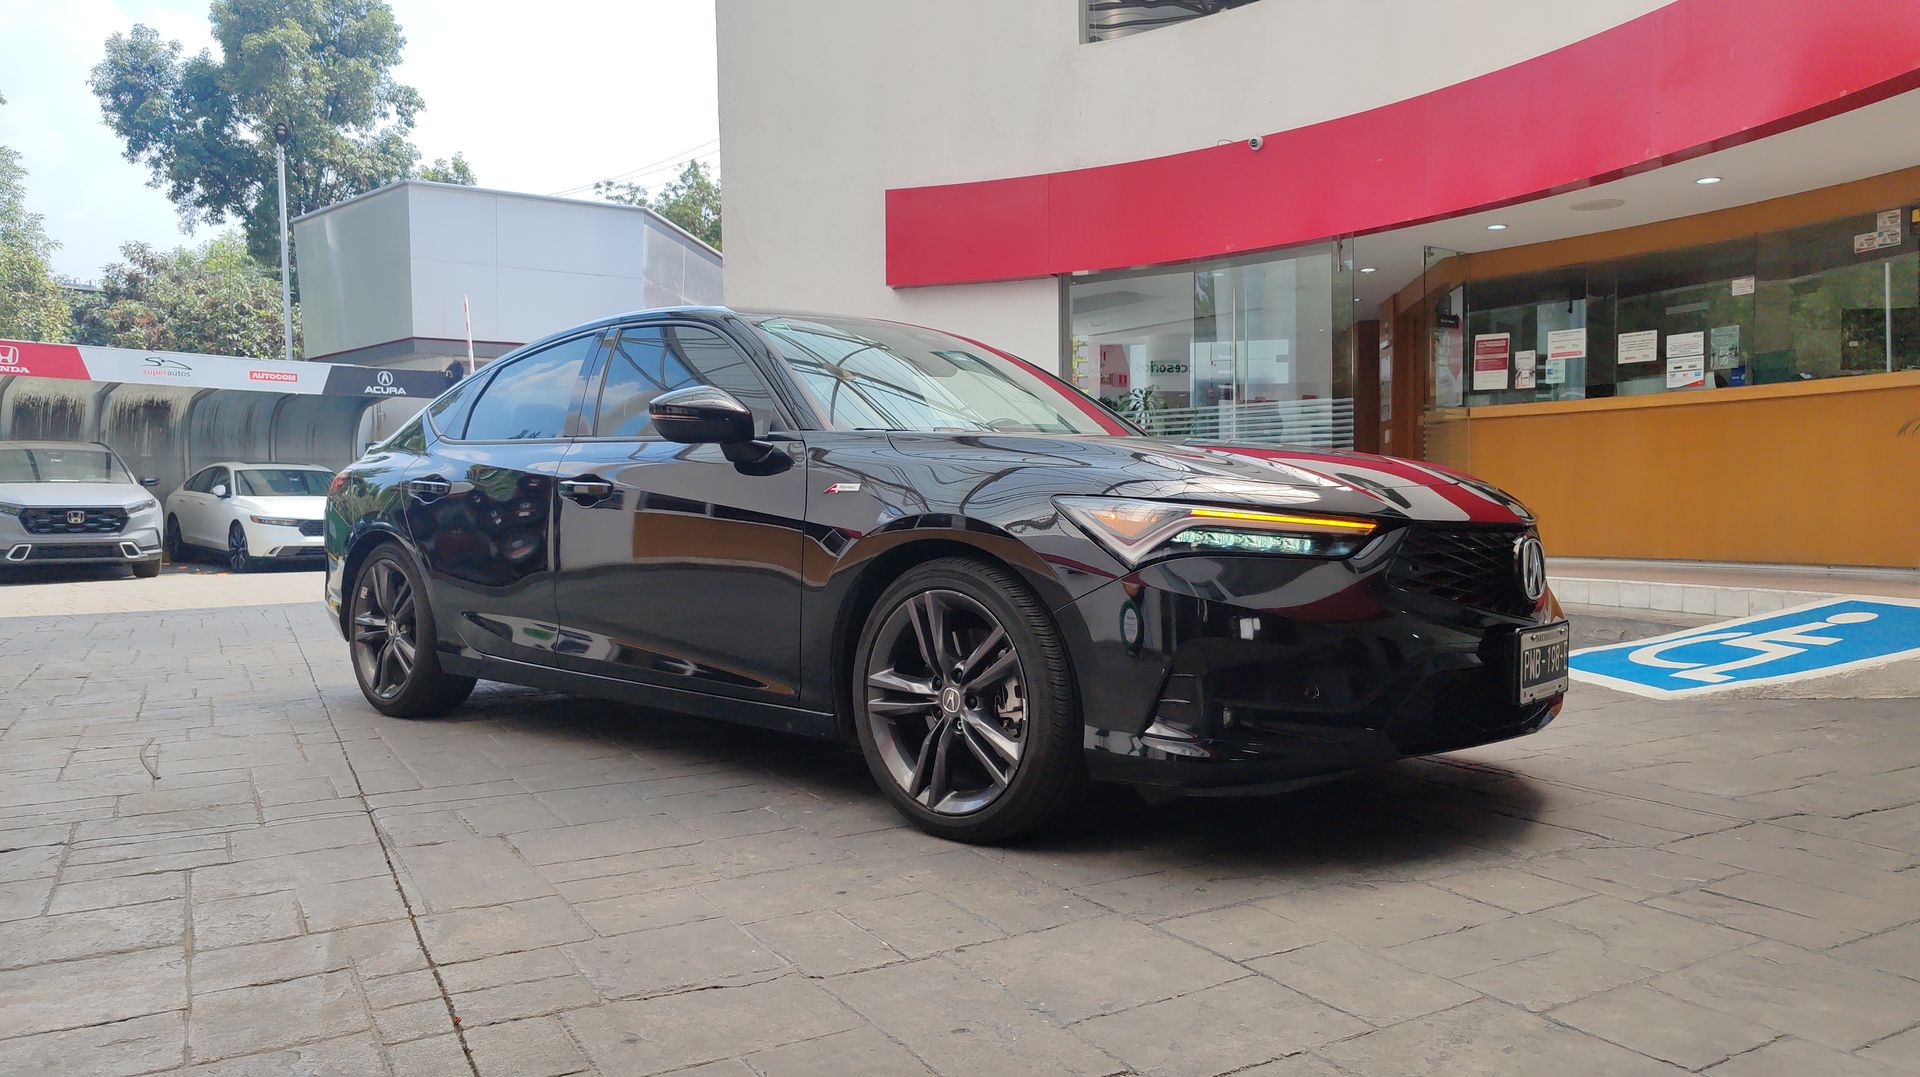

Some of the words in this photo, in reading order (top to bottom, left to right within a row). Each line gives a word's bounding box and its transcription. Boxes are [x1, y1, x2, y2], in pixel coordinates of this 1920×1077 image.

[0, 366, 31, 374] NDA
[143, 368, 191, 377] superautos
[250, 372, 296, 381] AUTOCOM
[363, 385, 406, 396] ACURA
